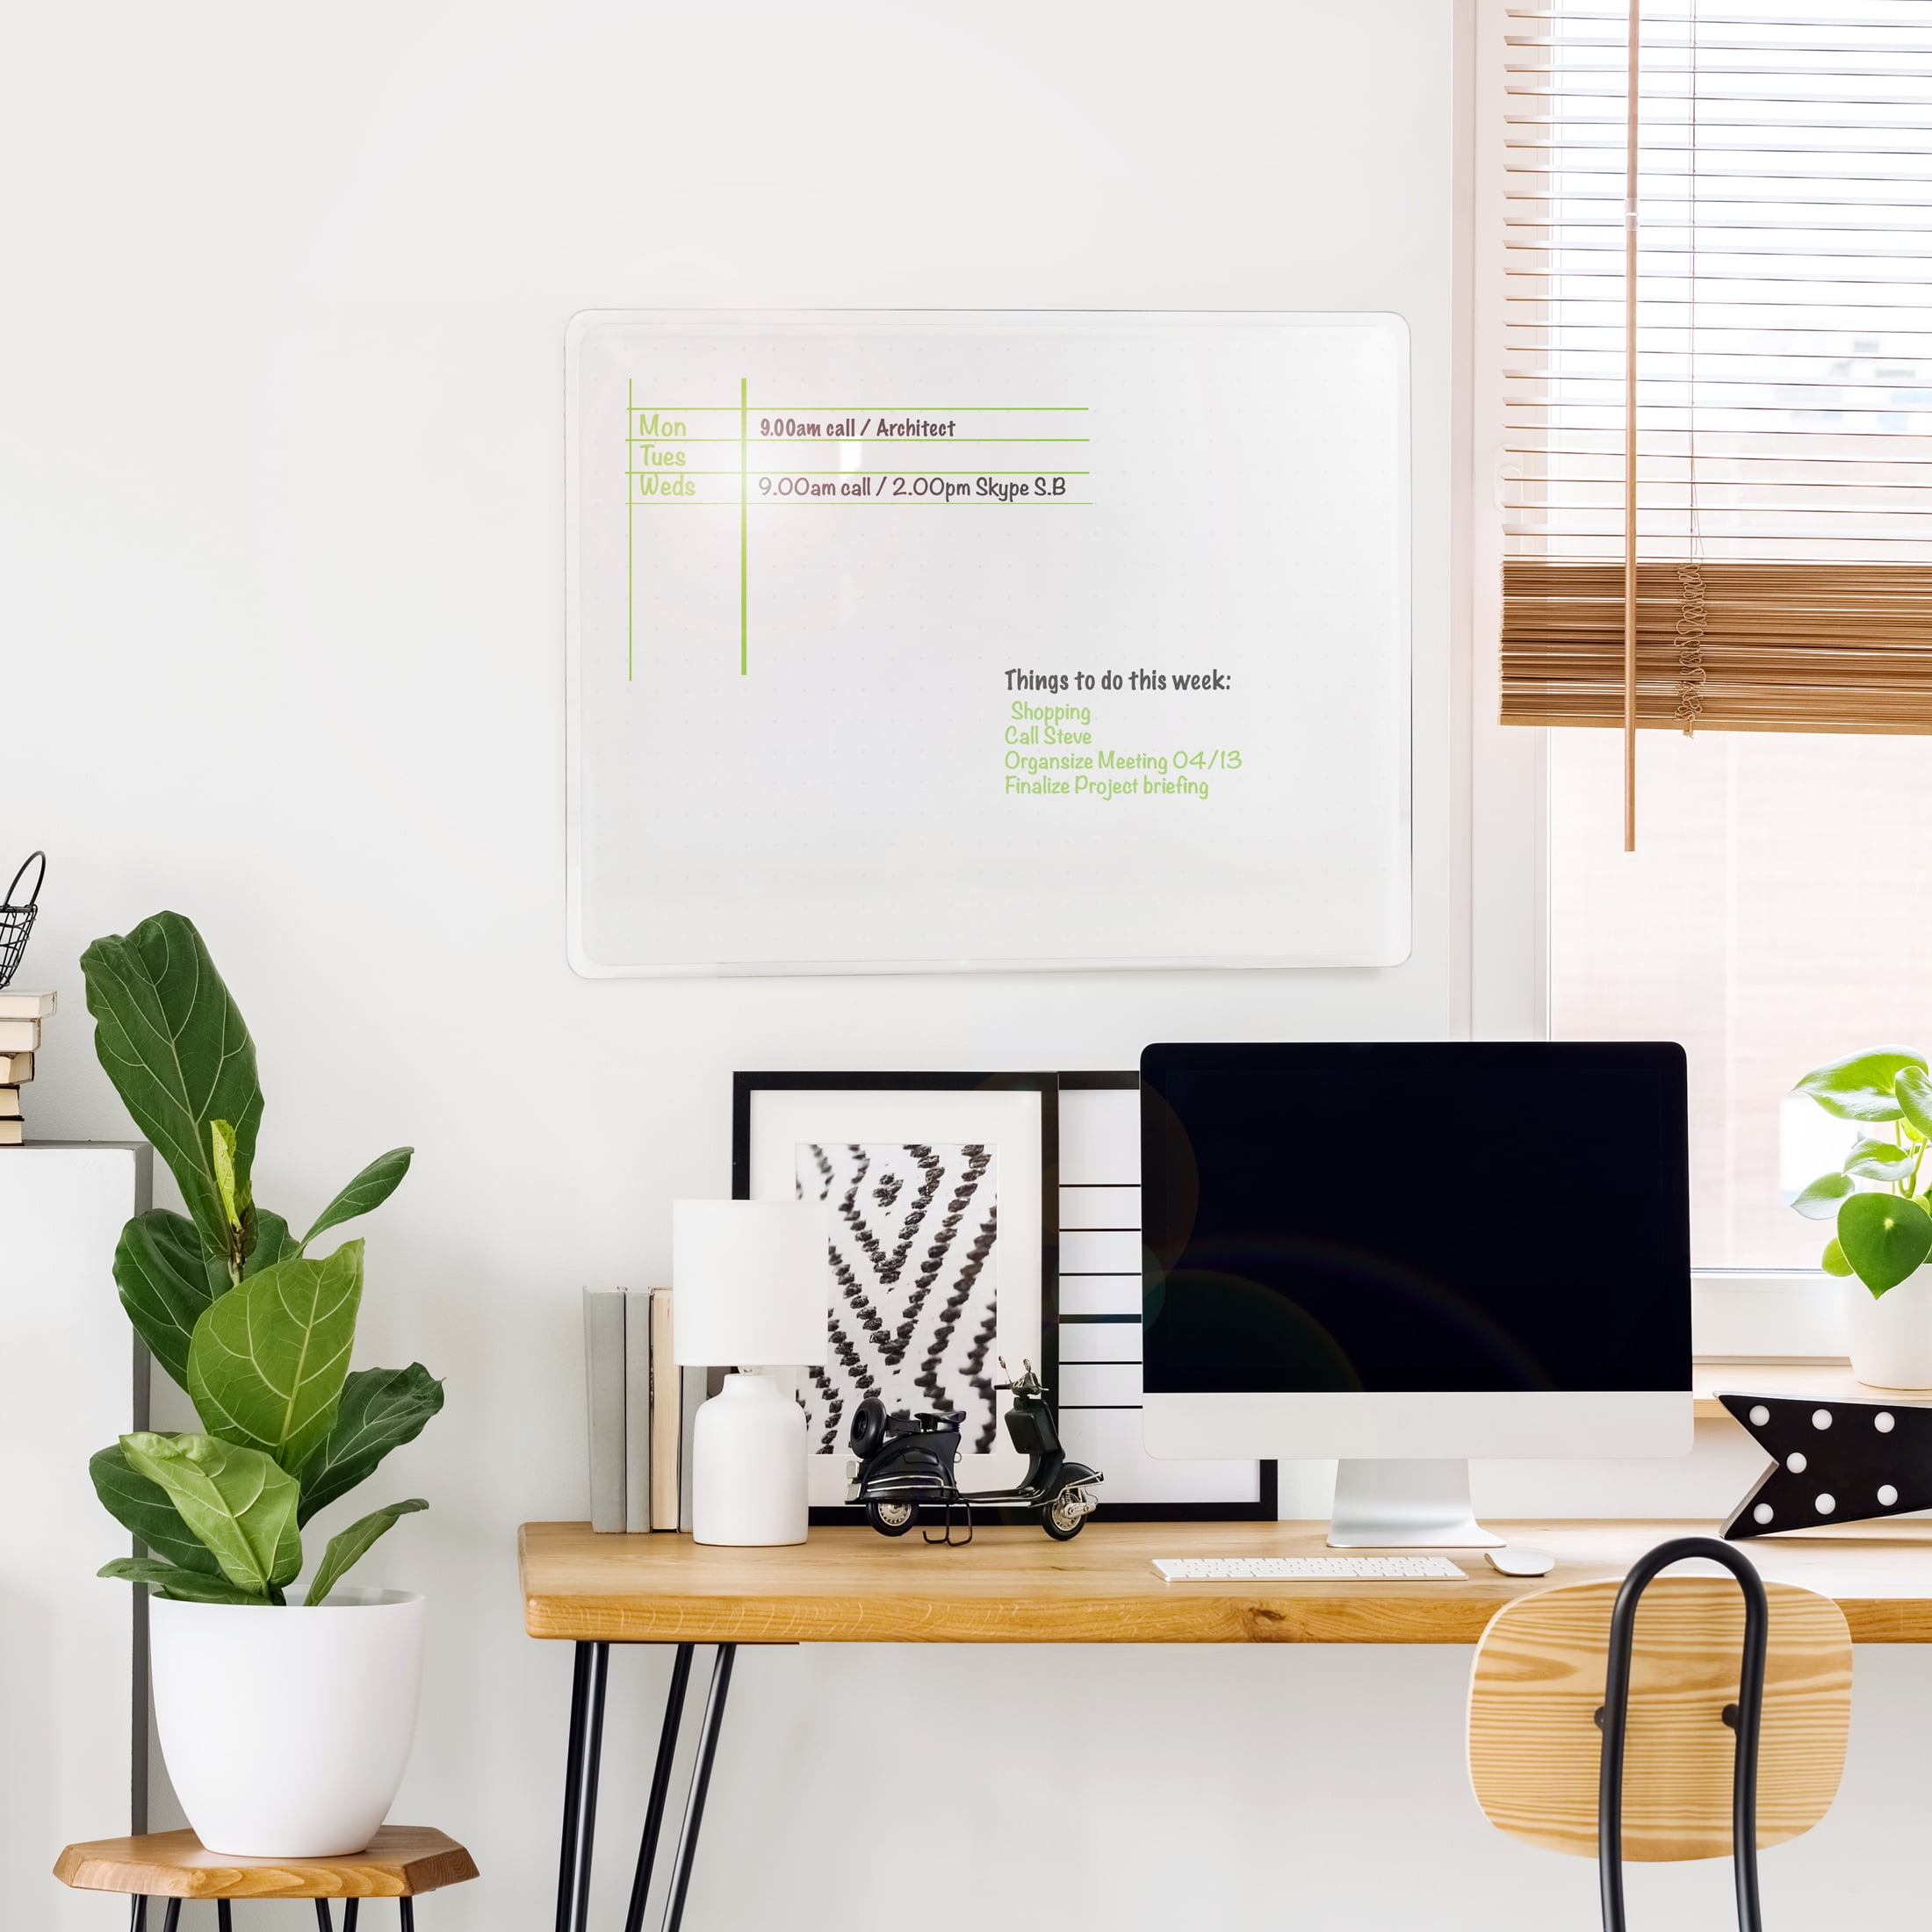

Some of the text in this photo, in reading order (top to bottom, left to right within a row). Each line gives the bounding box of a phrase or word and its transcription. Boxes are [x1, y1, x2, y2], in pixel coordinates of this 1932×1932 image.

[639, 414, 687, 436] Mon
[760, 418, 955, 437] 9.00am call / Architect
[639, 444, 687, 467] Tues
[639, 474, 696, 497] Weds
[759, 477, 1066, 501] 9.00am call / 2.00pm Skype S.B
[1005, 668, 1231, 694] Things to do this week:
[1012, 701, 1091, 726] Shopping
[1005, 725, 1092, 745] Call Steve
[1005, 750, 1243, 775] Organsize Meeting 04/13
[1005, 775, 1208, 800] Finalize Project briefing
